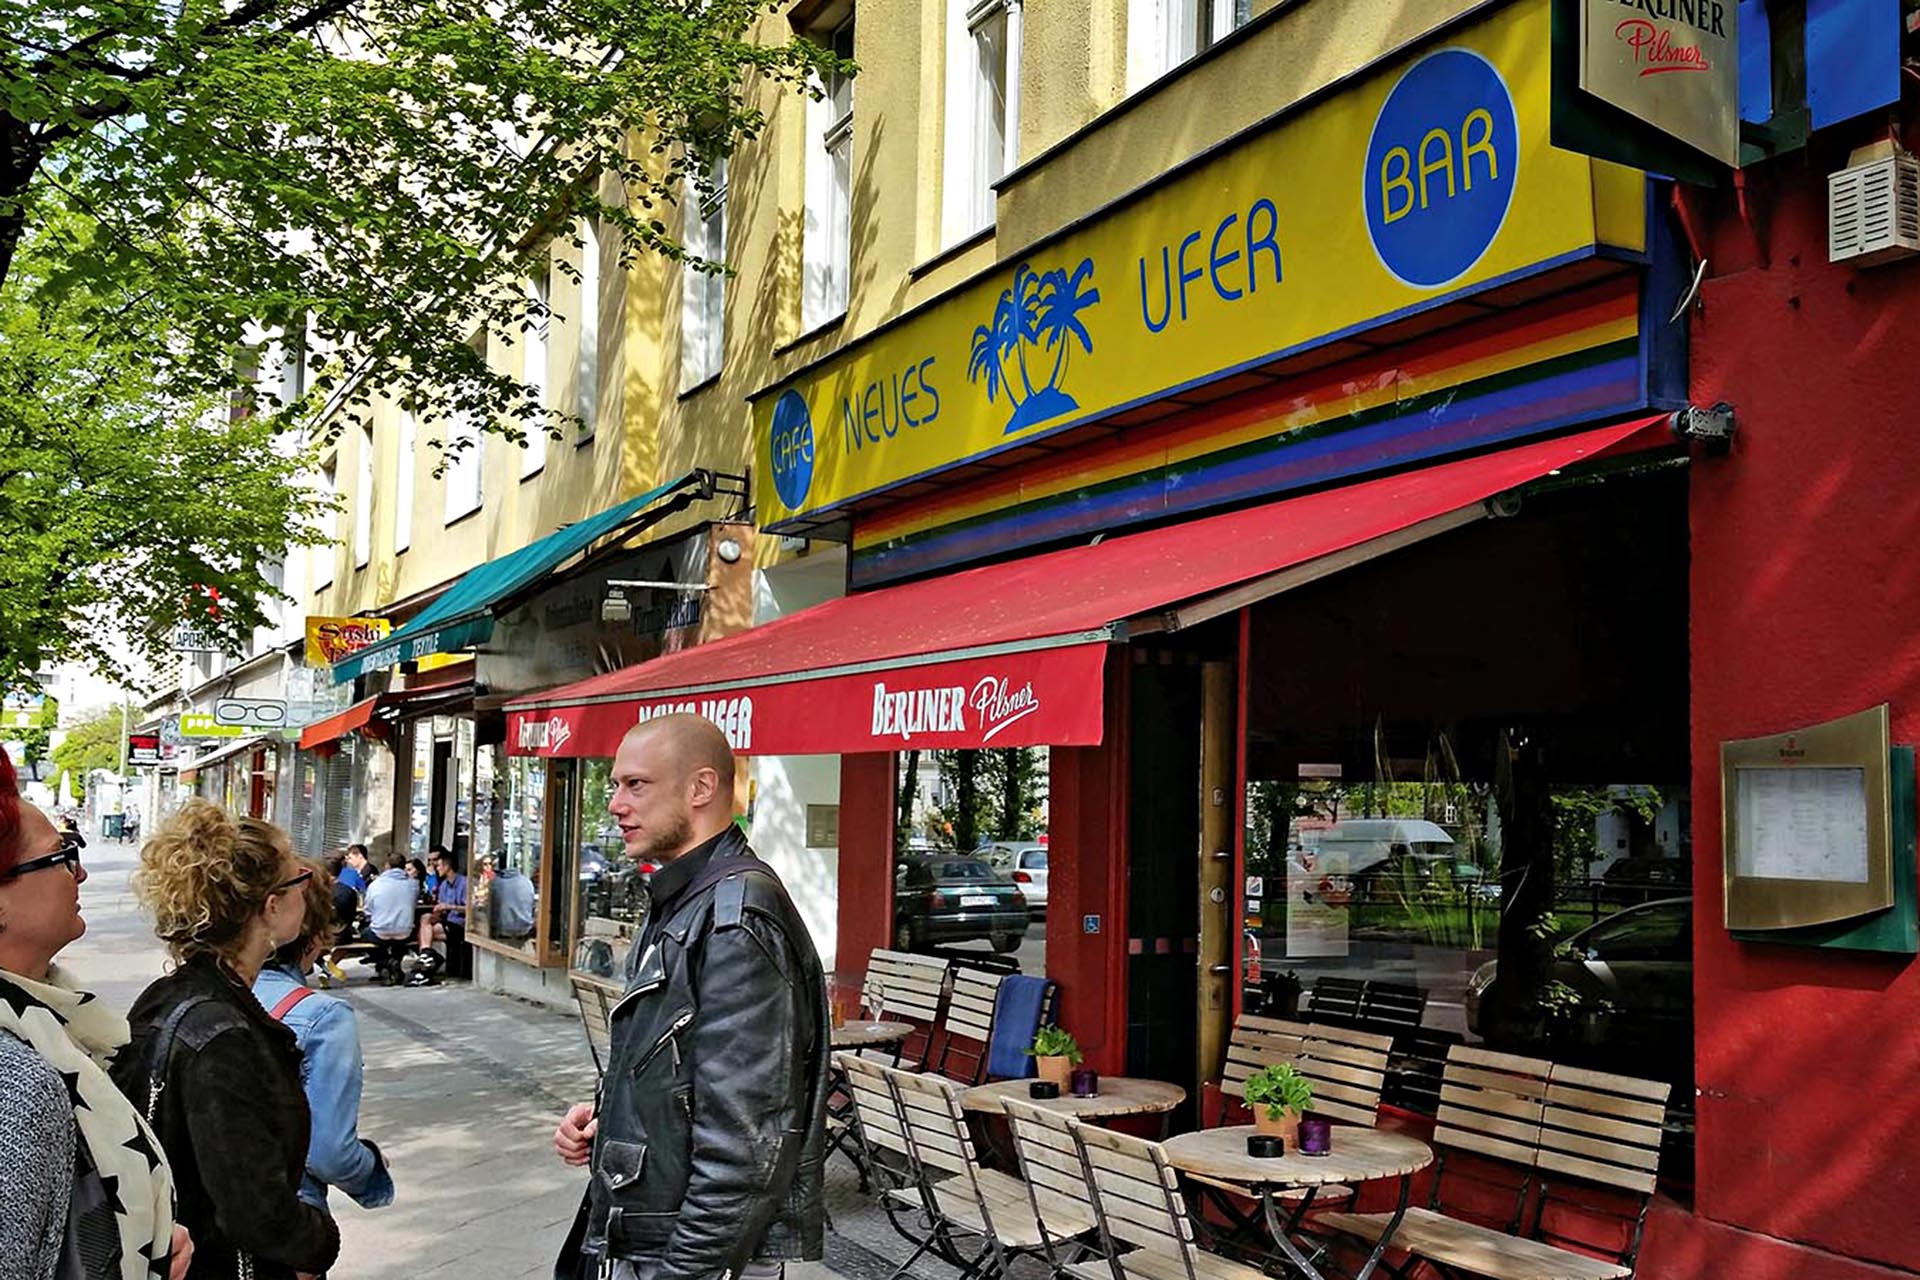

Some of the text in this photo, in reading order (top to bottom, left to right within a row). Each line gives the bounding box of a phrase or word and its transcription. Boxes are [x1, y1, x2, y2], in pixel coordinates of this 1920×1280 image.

[1615, 18, 1709, 76] Pilsner
[1381, 108, 1498, 225] BAR
[843, 198, 1282, 454] NEUES UFER
[318, 622, 381, 642] Sushi
[871, 675, 1039, 743] BERLINER Pilsner
